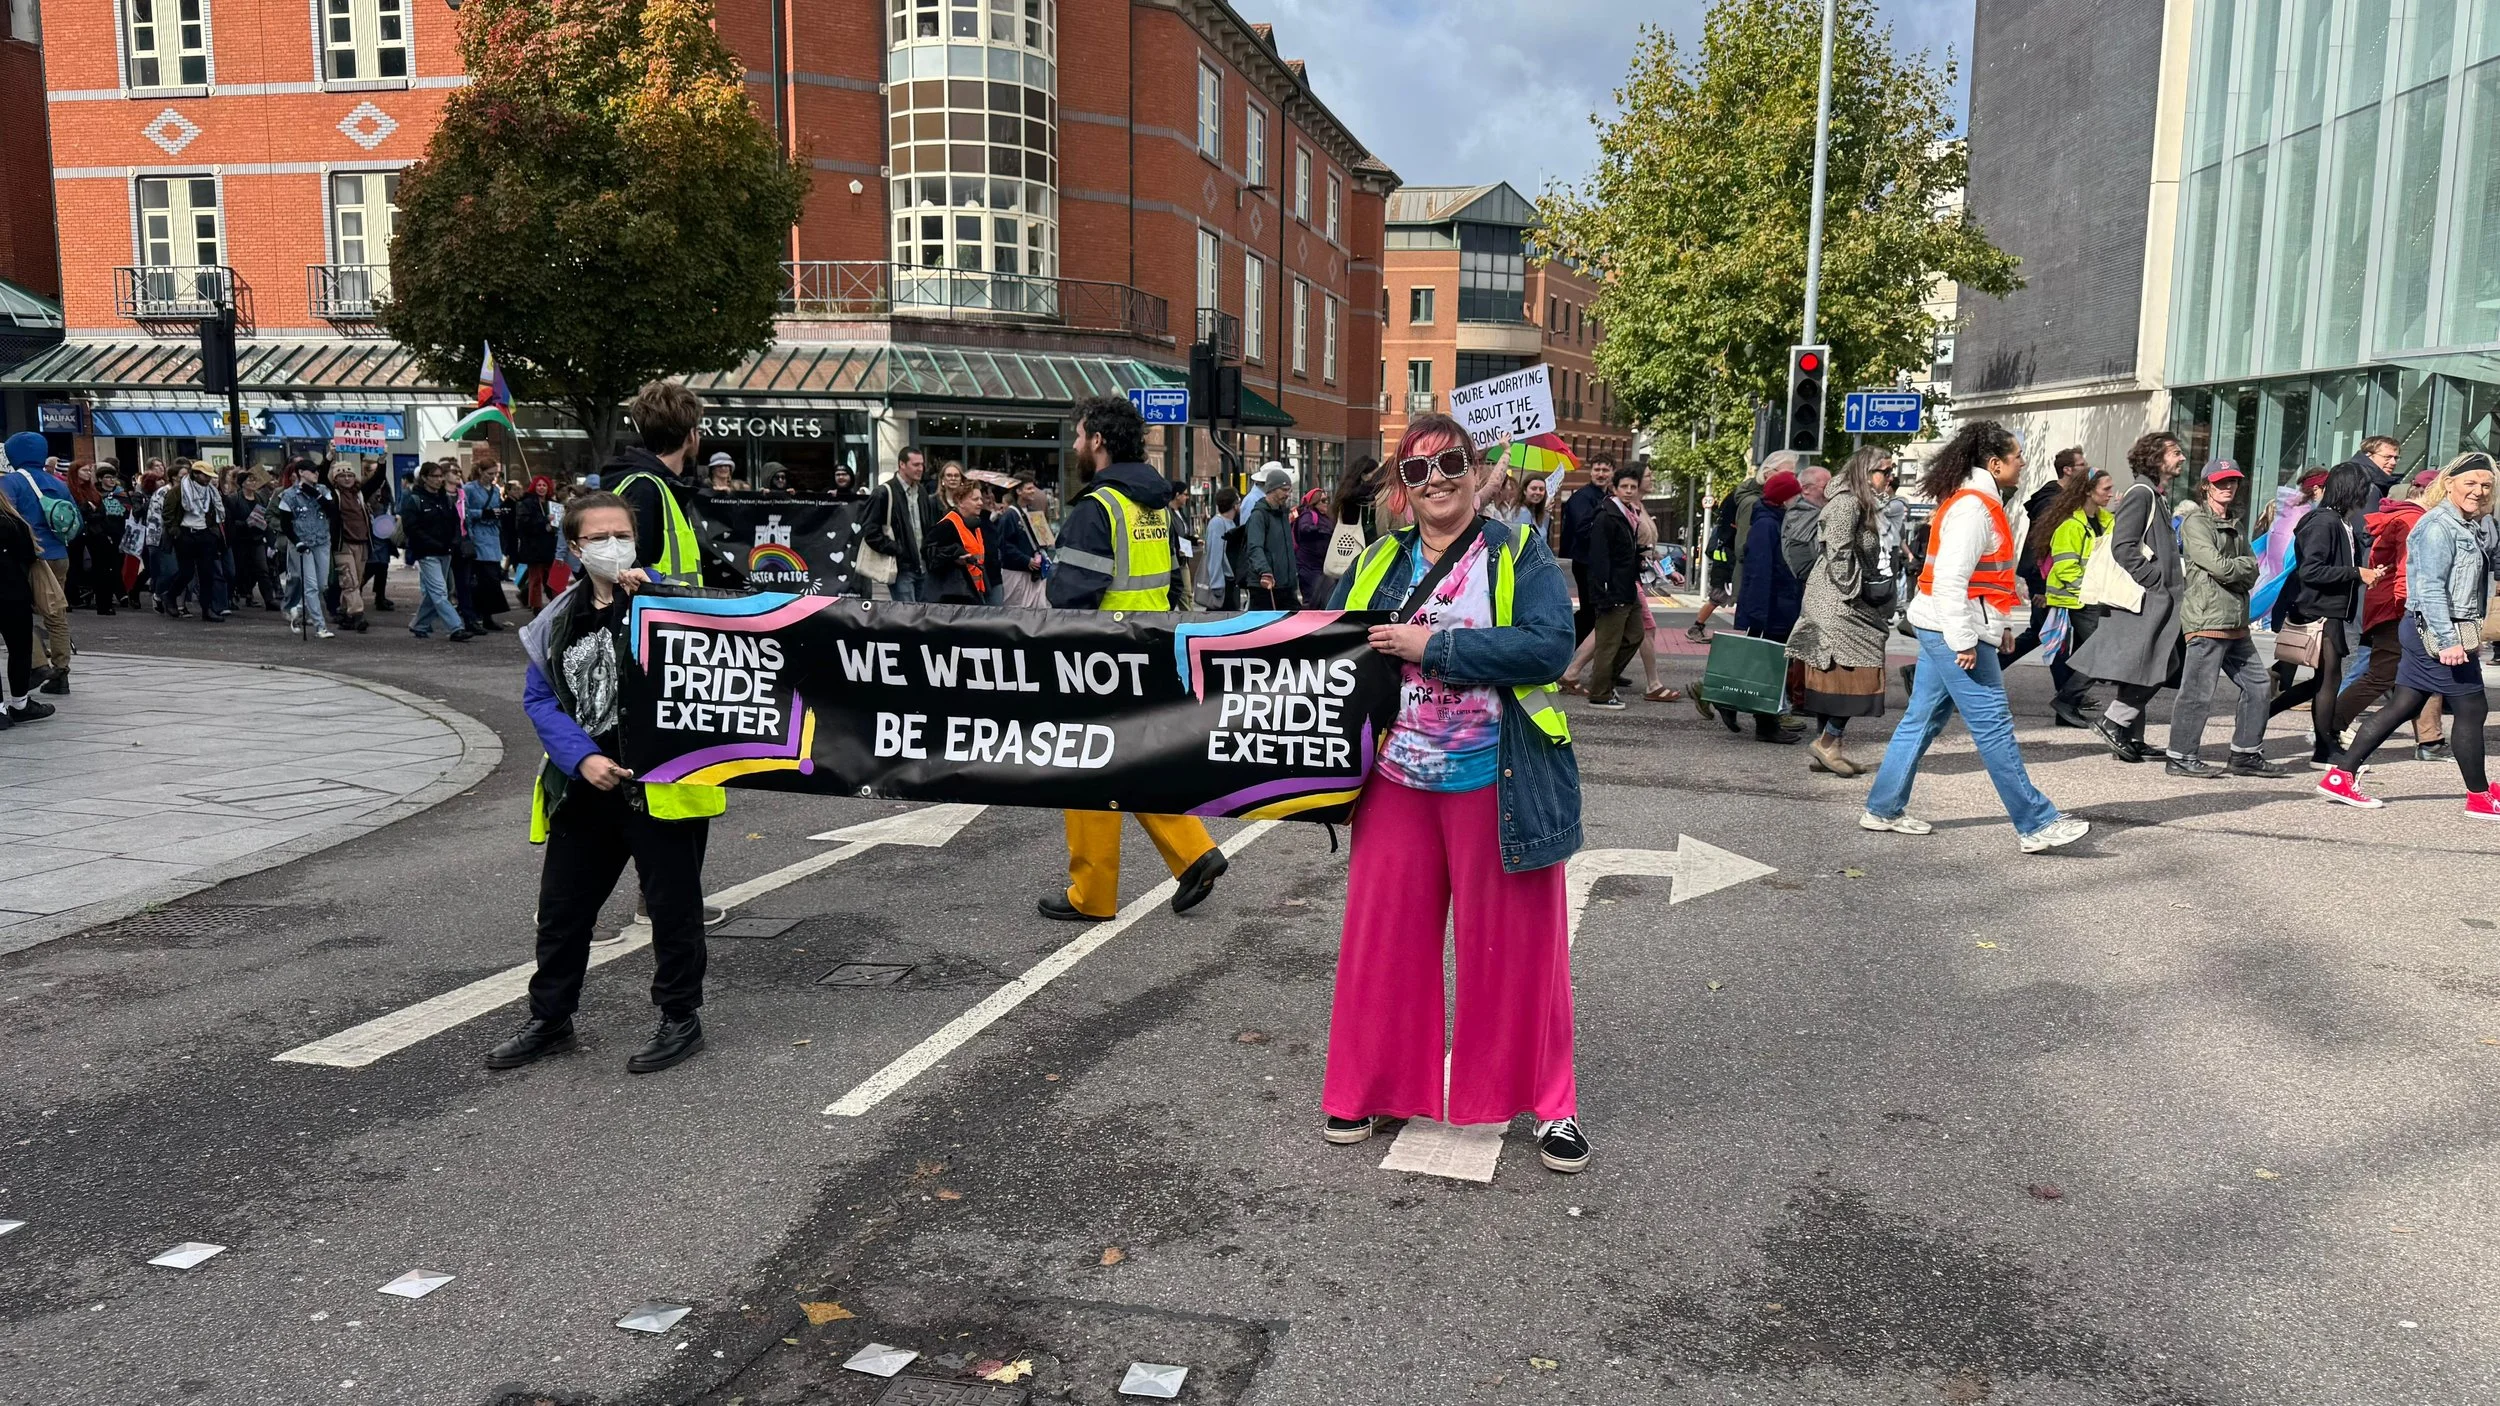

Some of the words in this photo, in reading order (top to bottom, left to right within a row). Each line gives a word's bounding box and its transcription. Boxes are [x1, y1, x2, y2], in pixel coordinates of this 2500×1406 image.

[1452, 386, 1484, 407] YOU'RE
[1488, 370, 1543, 396] WORRYING
[341, 422, 378, 430] RIGHTS
[1468, 403, 1503, 425] ABOUT
[1507, 396, 1533, 415] THE
[344, 428, 371, 437] ARE
[345, 438, 379, 446] HUMAN
[387, 429, 400, 437] 252
[702, 417, 822, 438] RSTONES
[1472, 426, 1504, 446] RONG
[1511, 413, 1540, 434] 1%
[340, 445, 379, 453] RIGHTS
[777, 571, 809, 583] PRIDE
[1410, 612, 1439, 626] ARE
[656, 629, 785, 670] TRANS
[837, 639, 908, 685] WE
[920, 644, 1040, 692] WILL
[1054, 651, 1149, 696] NOT
[1211, 658, 1357, 696] TRANS
[663, 665, 776, 705] PRIDE
[656, 701, 780, 736] EXETER
[1218, 693, 1344, 734] PRIDE
[874, 712, 927, 759] BE
[944, 716, 1115, 768] ERASED
[1208, 730, 1351, 768] EXETER
